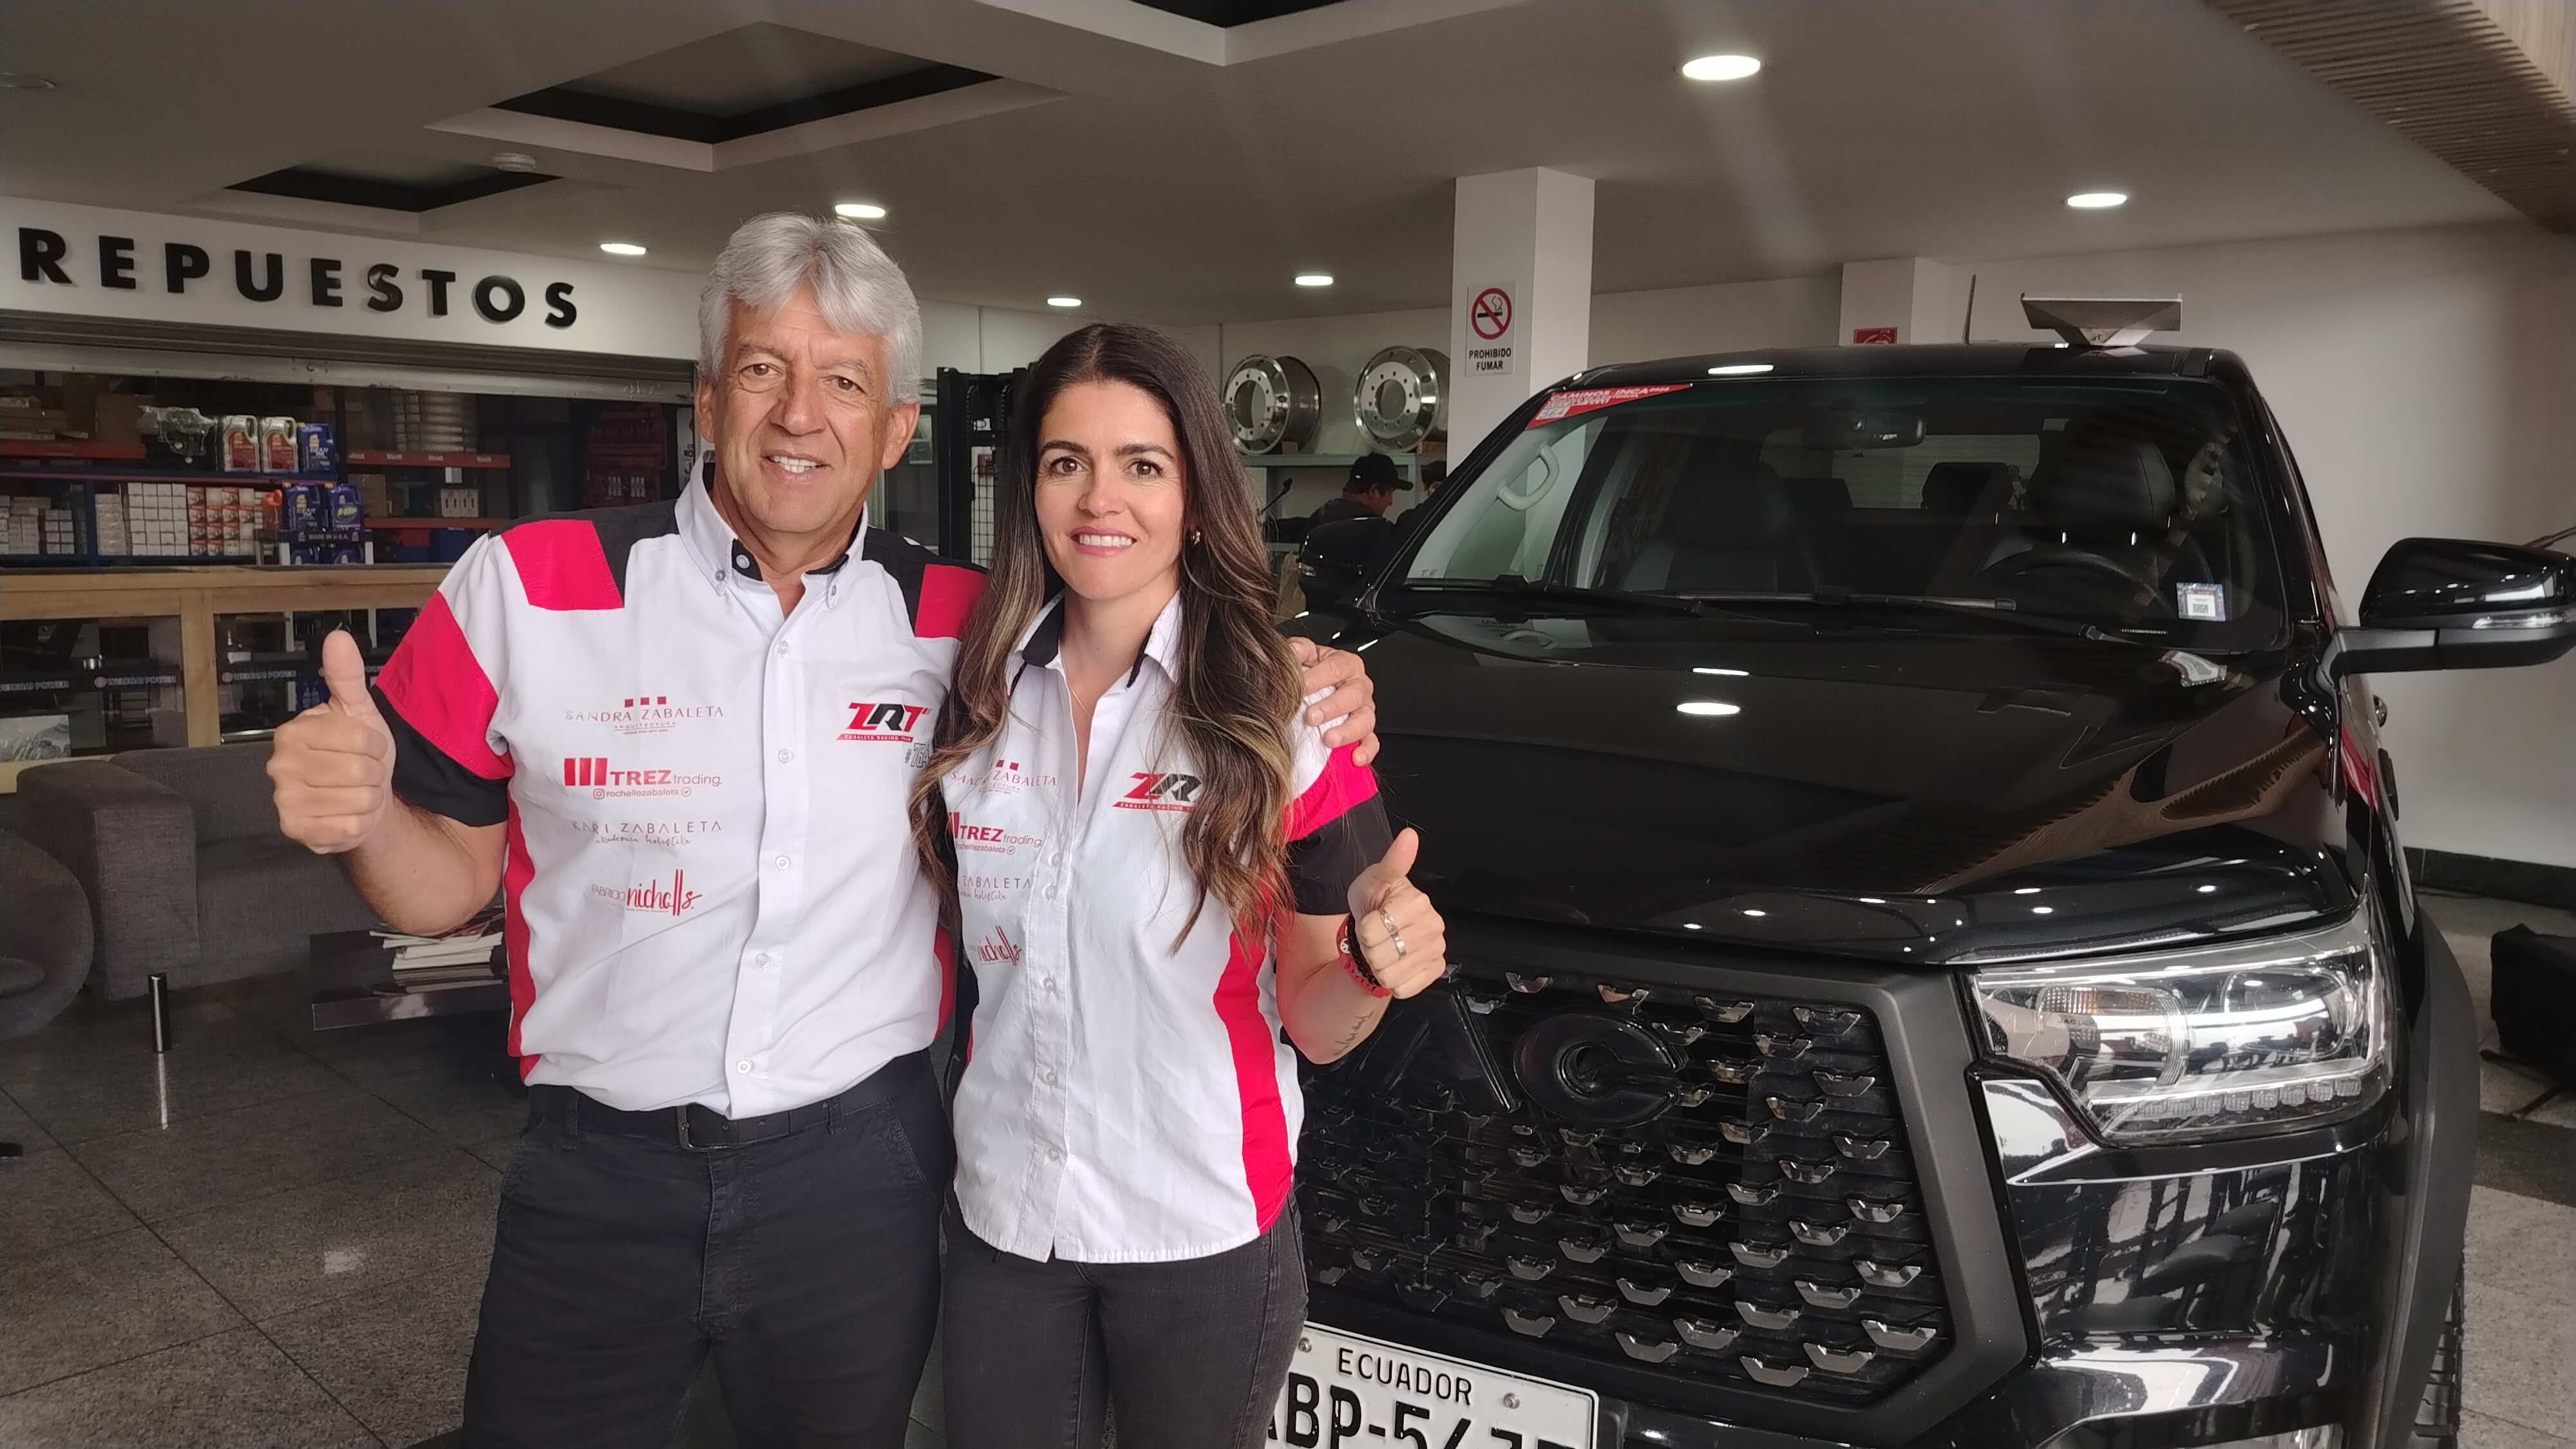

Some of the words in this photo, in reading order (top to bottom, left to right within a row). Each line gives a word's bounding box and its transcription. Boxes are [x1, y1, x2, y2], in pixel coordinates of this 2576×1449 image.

[18, 227, 578, 327] REPUESTOS
[1469, 348, 1511, 359] PROHIBIDO
[1476, 361, 1504, 371] FUMAR
[1550, 390, 1611, 401] CAMINOS
[564, 710, 632, 722] SANDRA
[641, 706, 724, 721] ZABALETA
[614, 721, 677, 729] ARQUITECTURA
[610, 770, 672, 786] TREZ
[992, 770, 1056, 787] ZABALETA
[606, 788, 679, 798] rochellezabaleta
[571, 820, 609, 835] KARI
[620, 820, 722, 834] ZABALETA
[960, 825, 1005, 842] TREZ
[962, 875, 1031, 889] ZABALETA
[1336, 1347, 1473, 1406] ECUADOR
